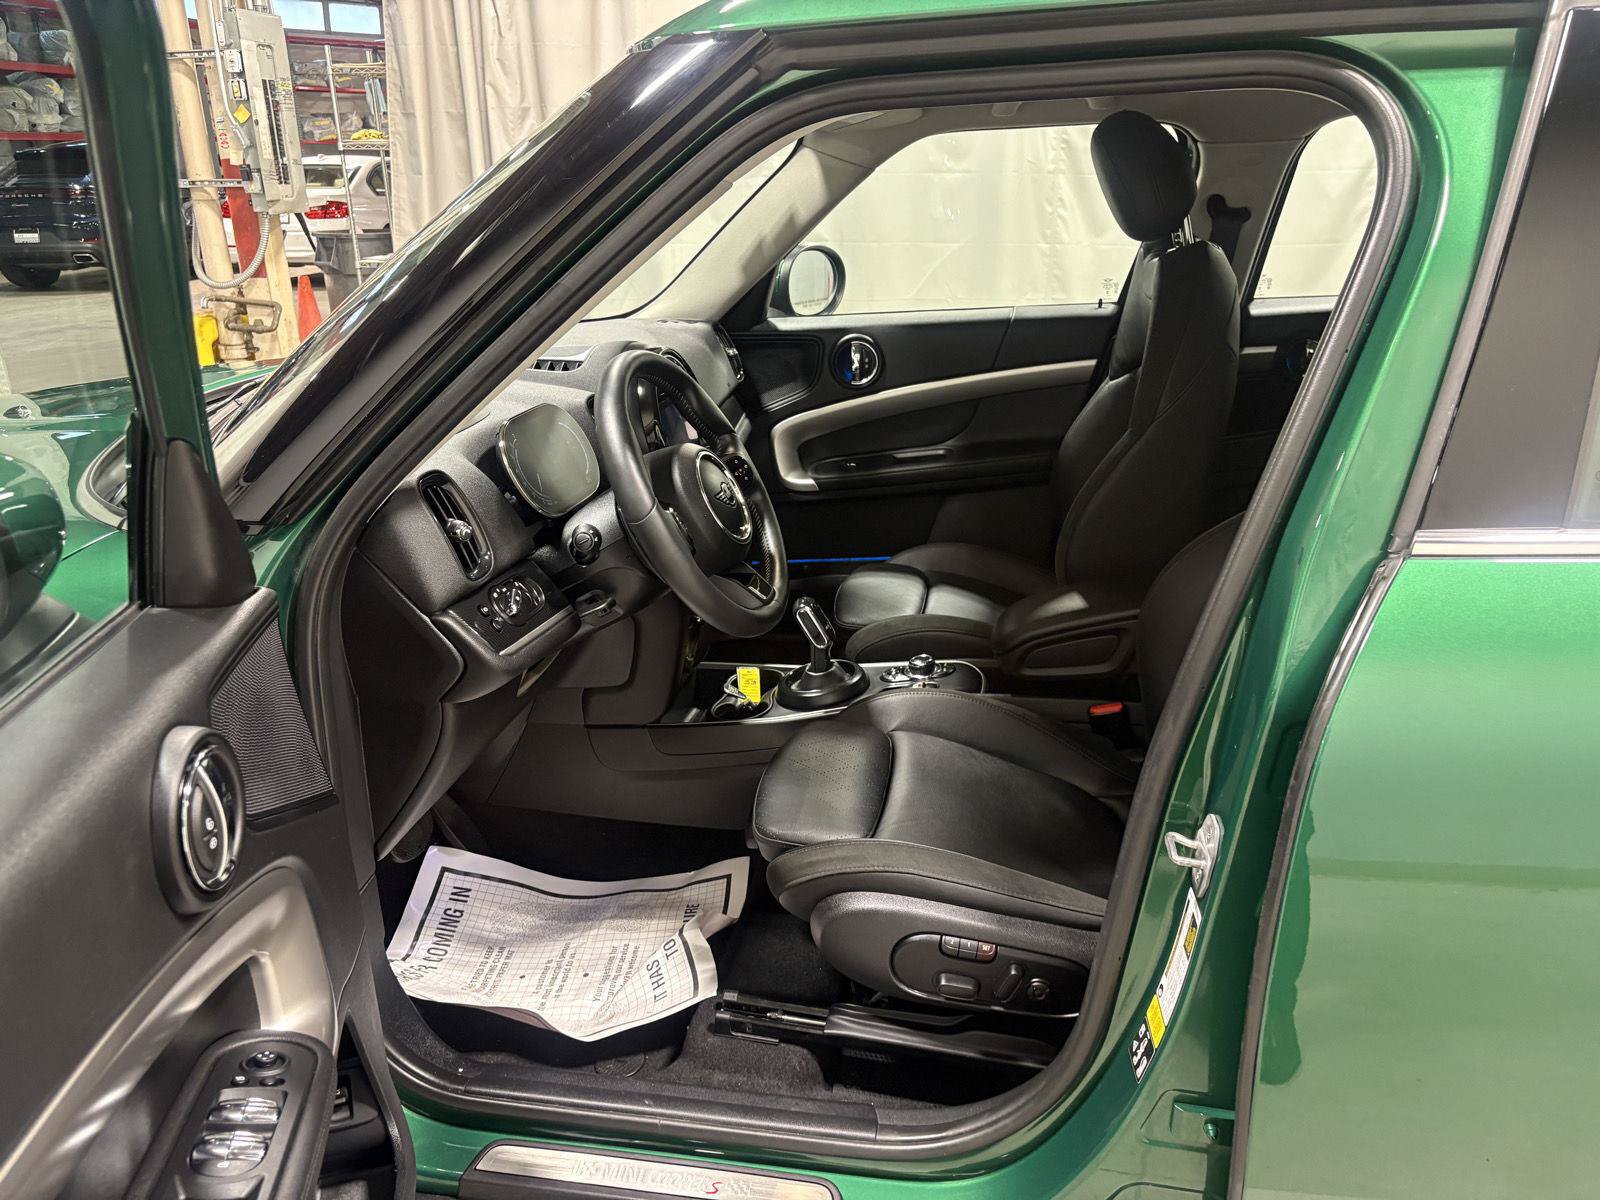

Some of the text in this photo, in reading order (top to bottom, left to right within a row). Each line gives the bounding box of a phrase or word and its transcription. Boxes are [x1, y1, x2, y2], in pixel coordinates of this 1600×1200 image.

[423, 886, 472, 963] COMING IN
[484, 945, 494, 960] KEEP
[491, 946, 507, 964] CLEAN
[558, 942, 571, 960] person
[618, 943, 630, 963] service
[663, 938, 678, 960] TO
[496, 961, 511, 978] PAPER
[504, 949, 516, 960] MAT
[592, 986, 604, 1002] Your
[609, 945, 618, 955] for
[615, 964, 624, 974] our
[536, 965, 551, 991] customer
[560, 967, 573, 983] world
[646, 960, 667, 1003] IT HAS
[704, 1181, 722, 1195] S
